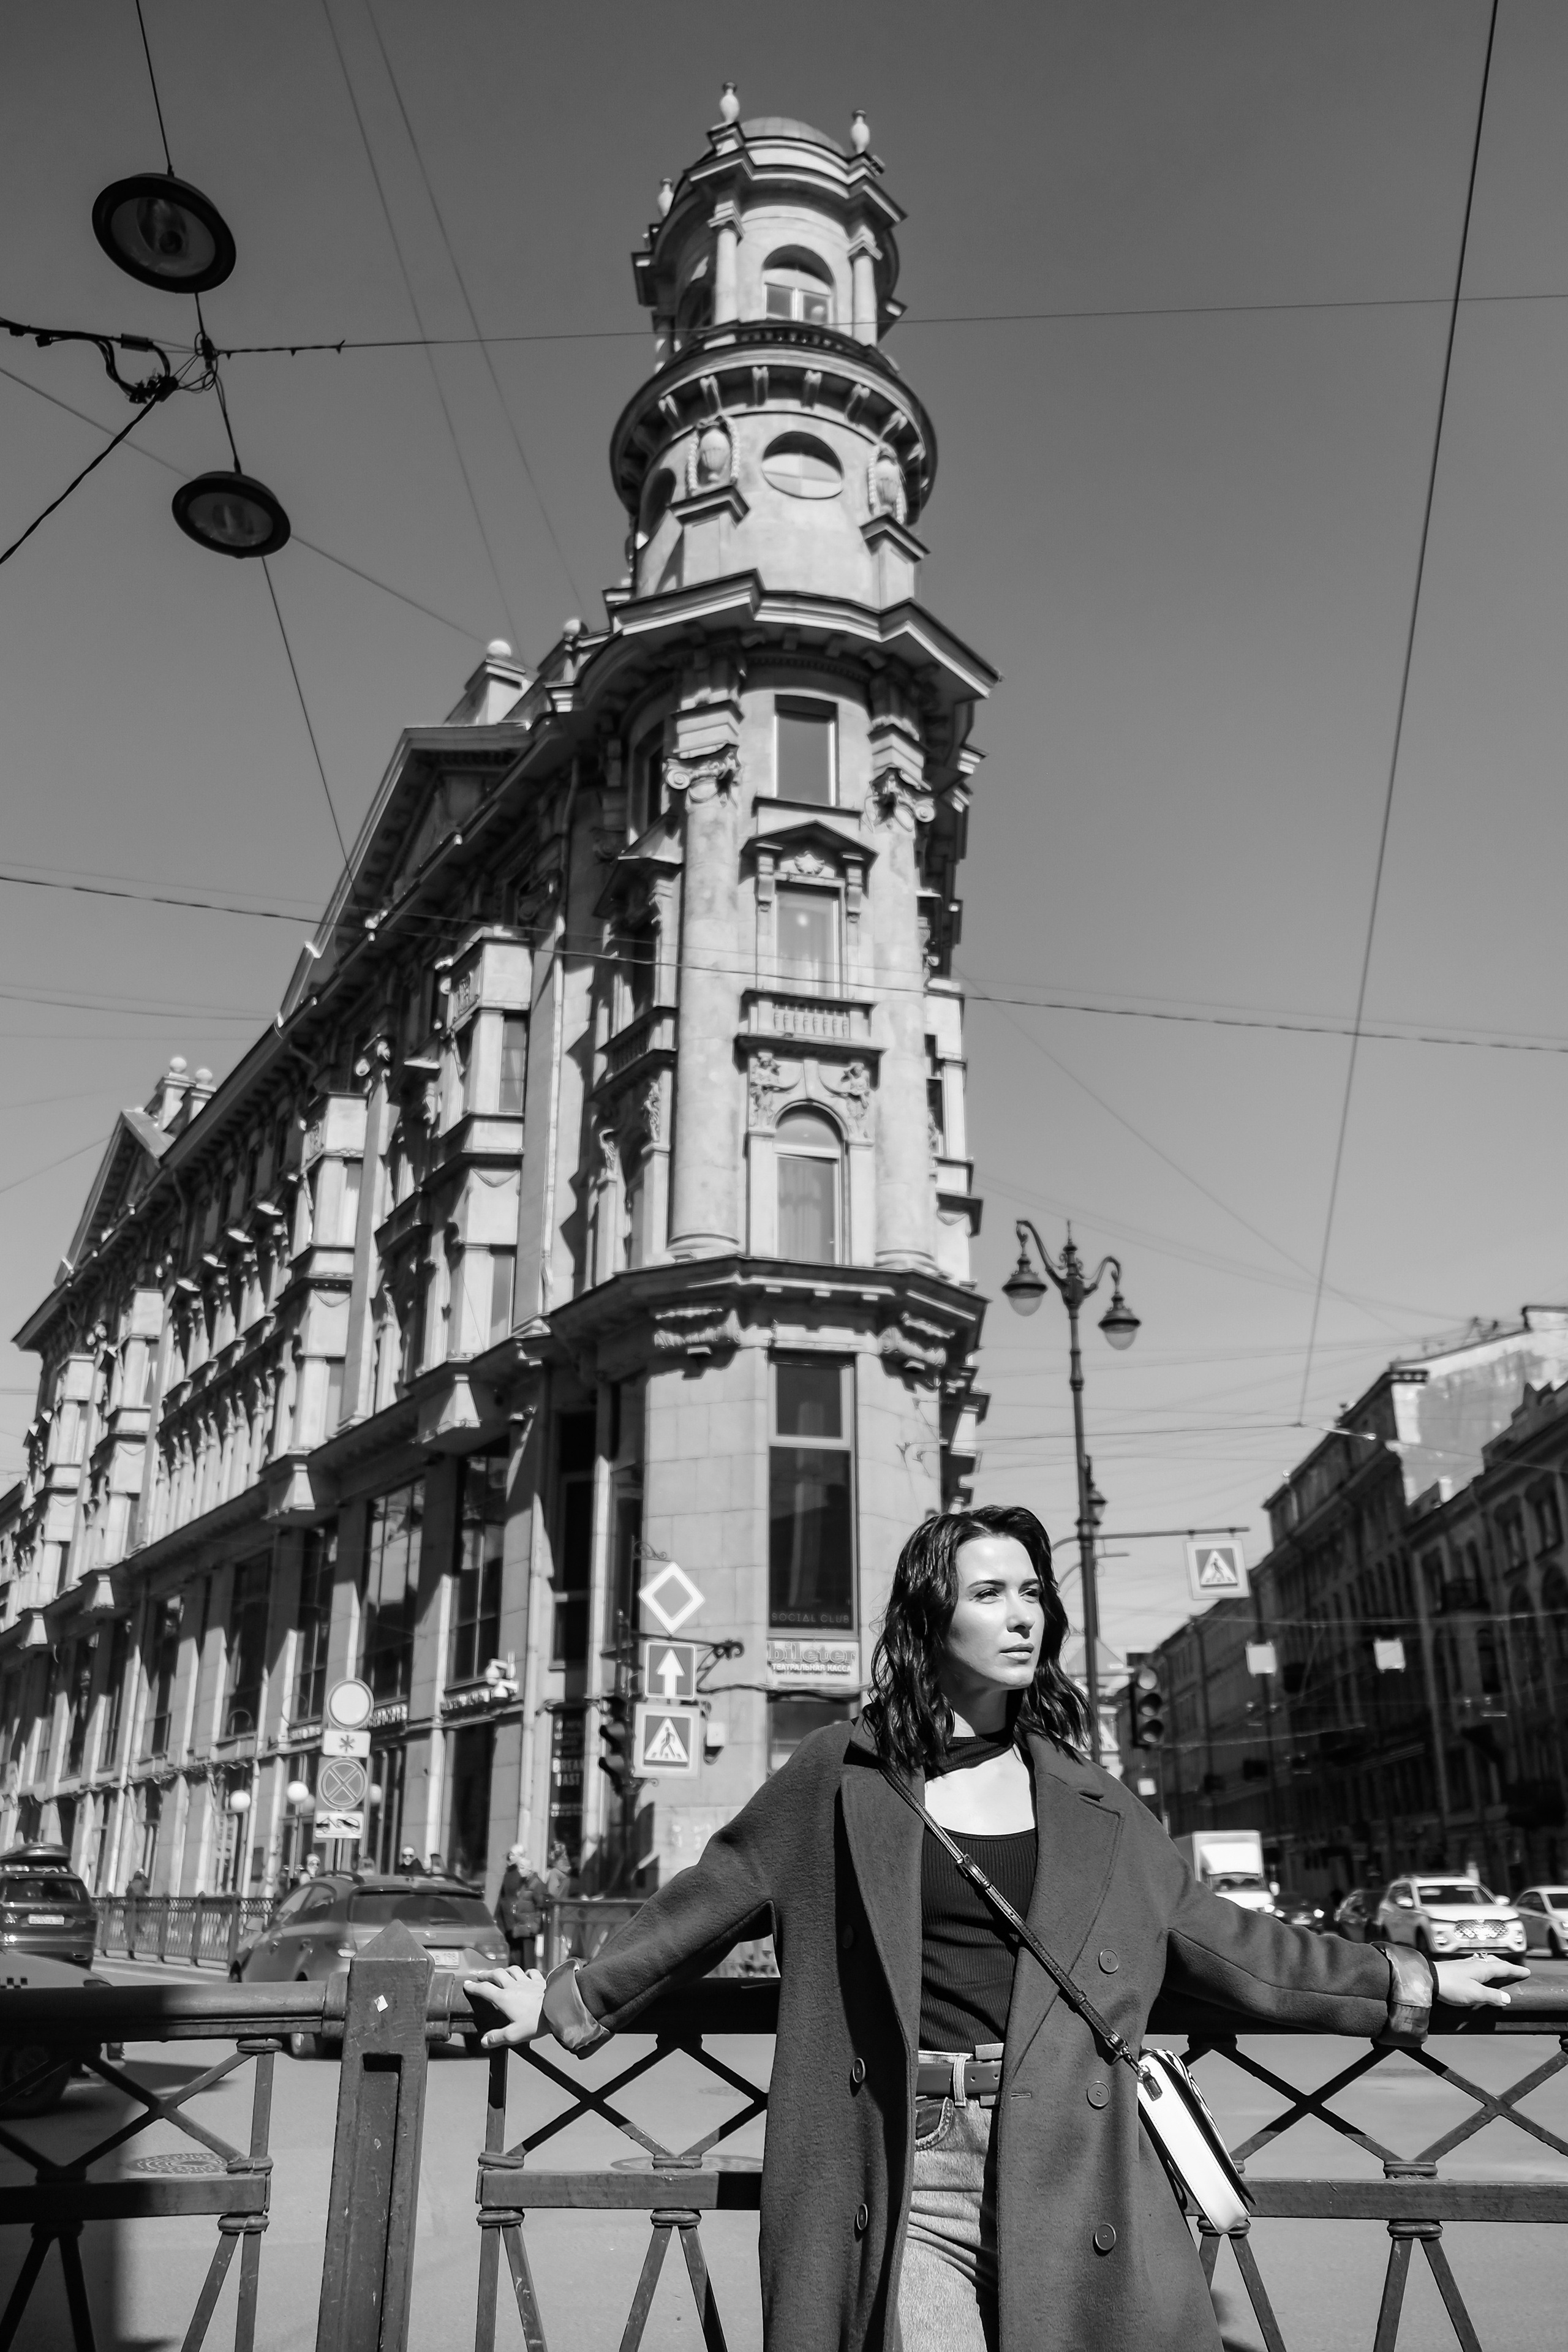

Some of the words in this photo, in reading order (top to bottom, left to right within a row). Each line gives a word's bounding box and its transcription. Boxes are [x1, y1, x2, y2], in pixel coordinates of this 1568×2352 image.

[771, 1613, 816, 1622] SOCIAL
[820, 1614, 850, 1623] CLUB
[767, 1642, 856, 1663] bileter
[772, 1663, 826, 1672] ТЕАТРАЛЬНАЯ
